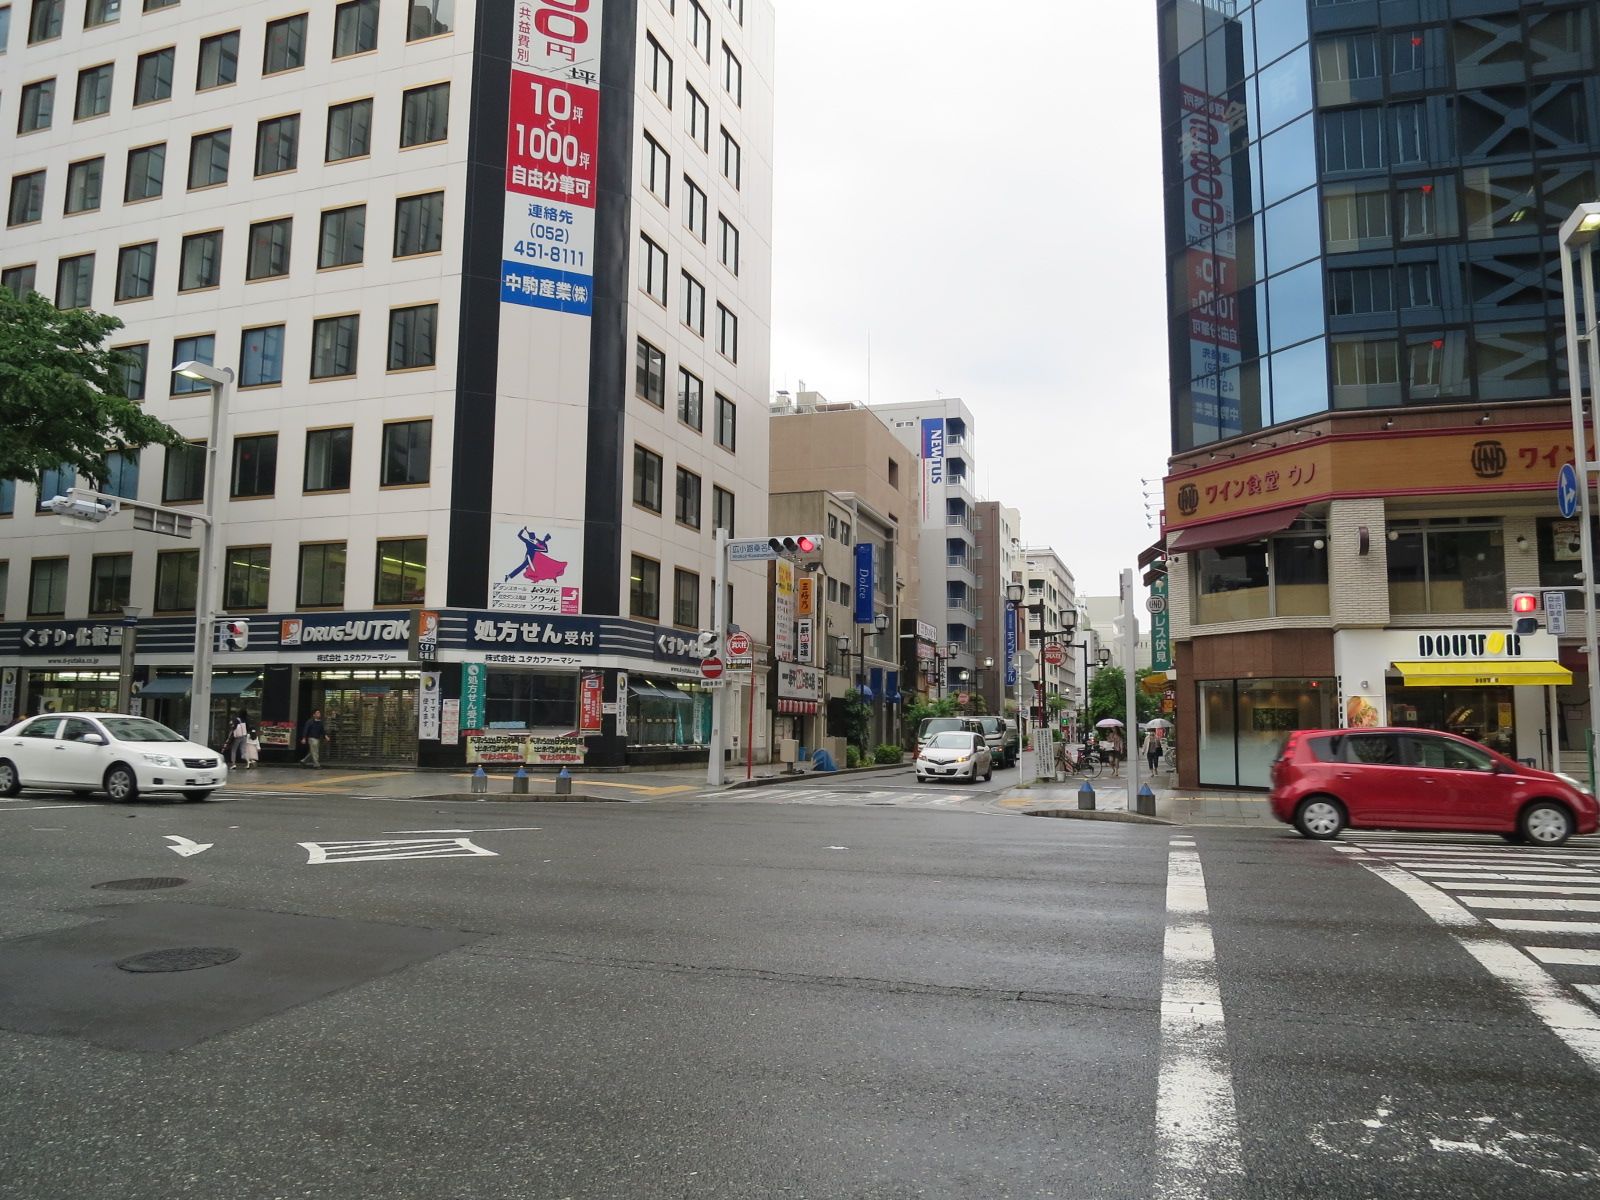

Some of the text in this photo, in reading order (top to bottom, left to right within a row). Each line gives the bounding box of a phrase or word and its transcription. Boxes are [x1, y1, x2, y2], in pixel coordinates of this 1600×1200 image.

[530, 82, 584, 125] 10坪
[515, 124, 590, 168] 1000坪
[527, 203, 573, 225] 連絡先
[530, 222, 569, 244] (052)
[514, 240, 584, 267] 451-8111
[930, 429, 943, 484] NEWTUS
[1205, 463, 1317, 504] ワイン食堂 ウノ
[859, 568, 869, 599] Dolce
[530, 603, 559, 611] ソワール
[420, 643, 435, 651] くすり
[731, 641, 747, 649] 消火栓
[1418, 632, 1521, 657] DOUTOR
[317, 654, 397, 662] 株式会社 ユタカファーマシー
[485, 654, 582, 664] 株式会社 ユタカファーマシー
[467, 676, 478, 728] 処方せん受付
